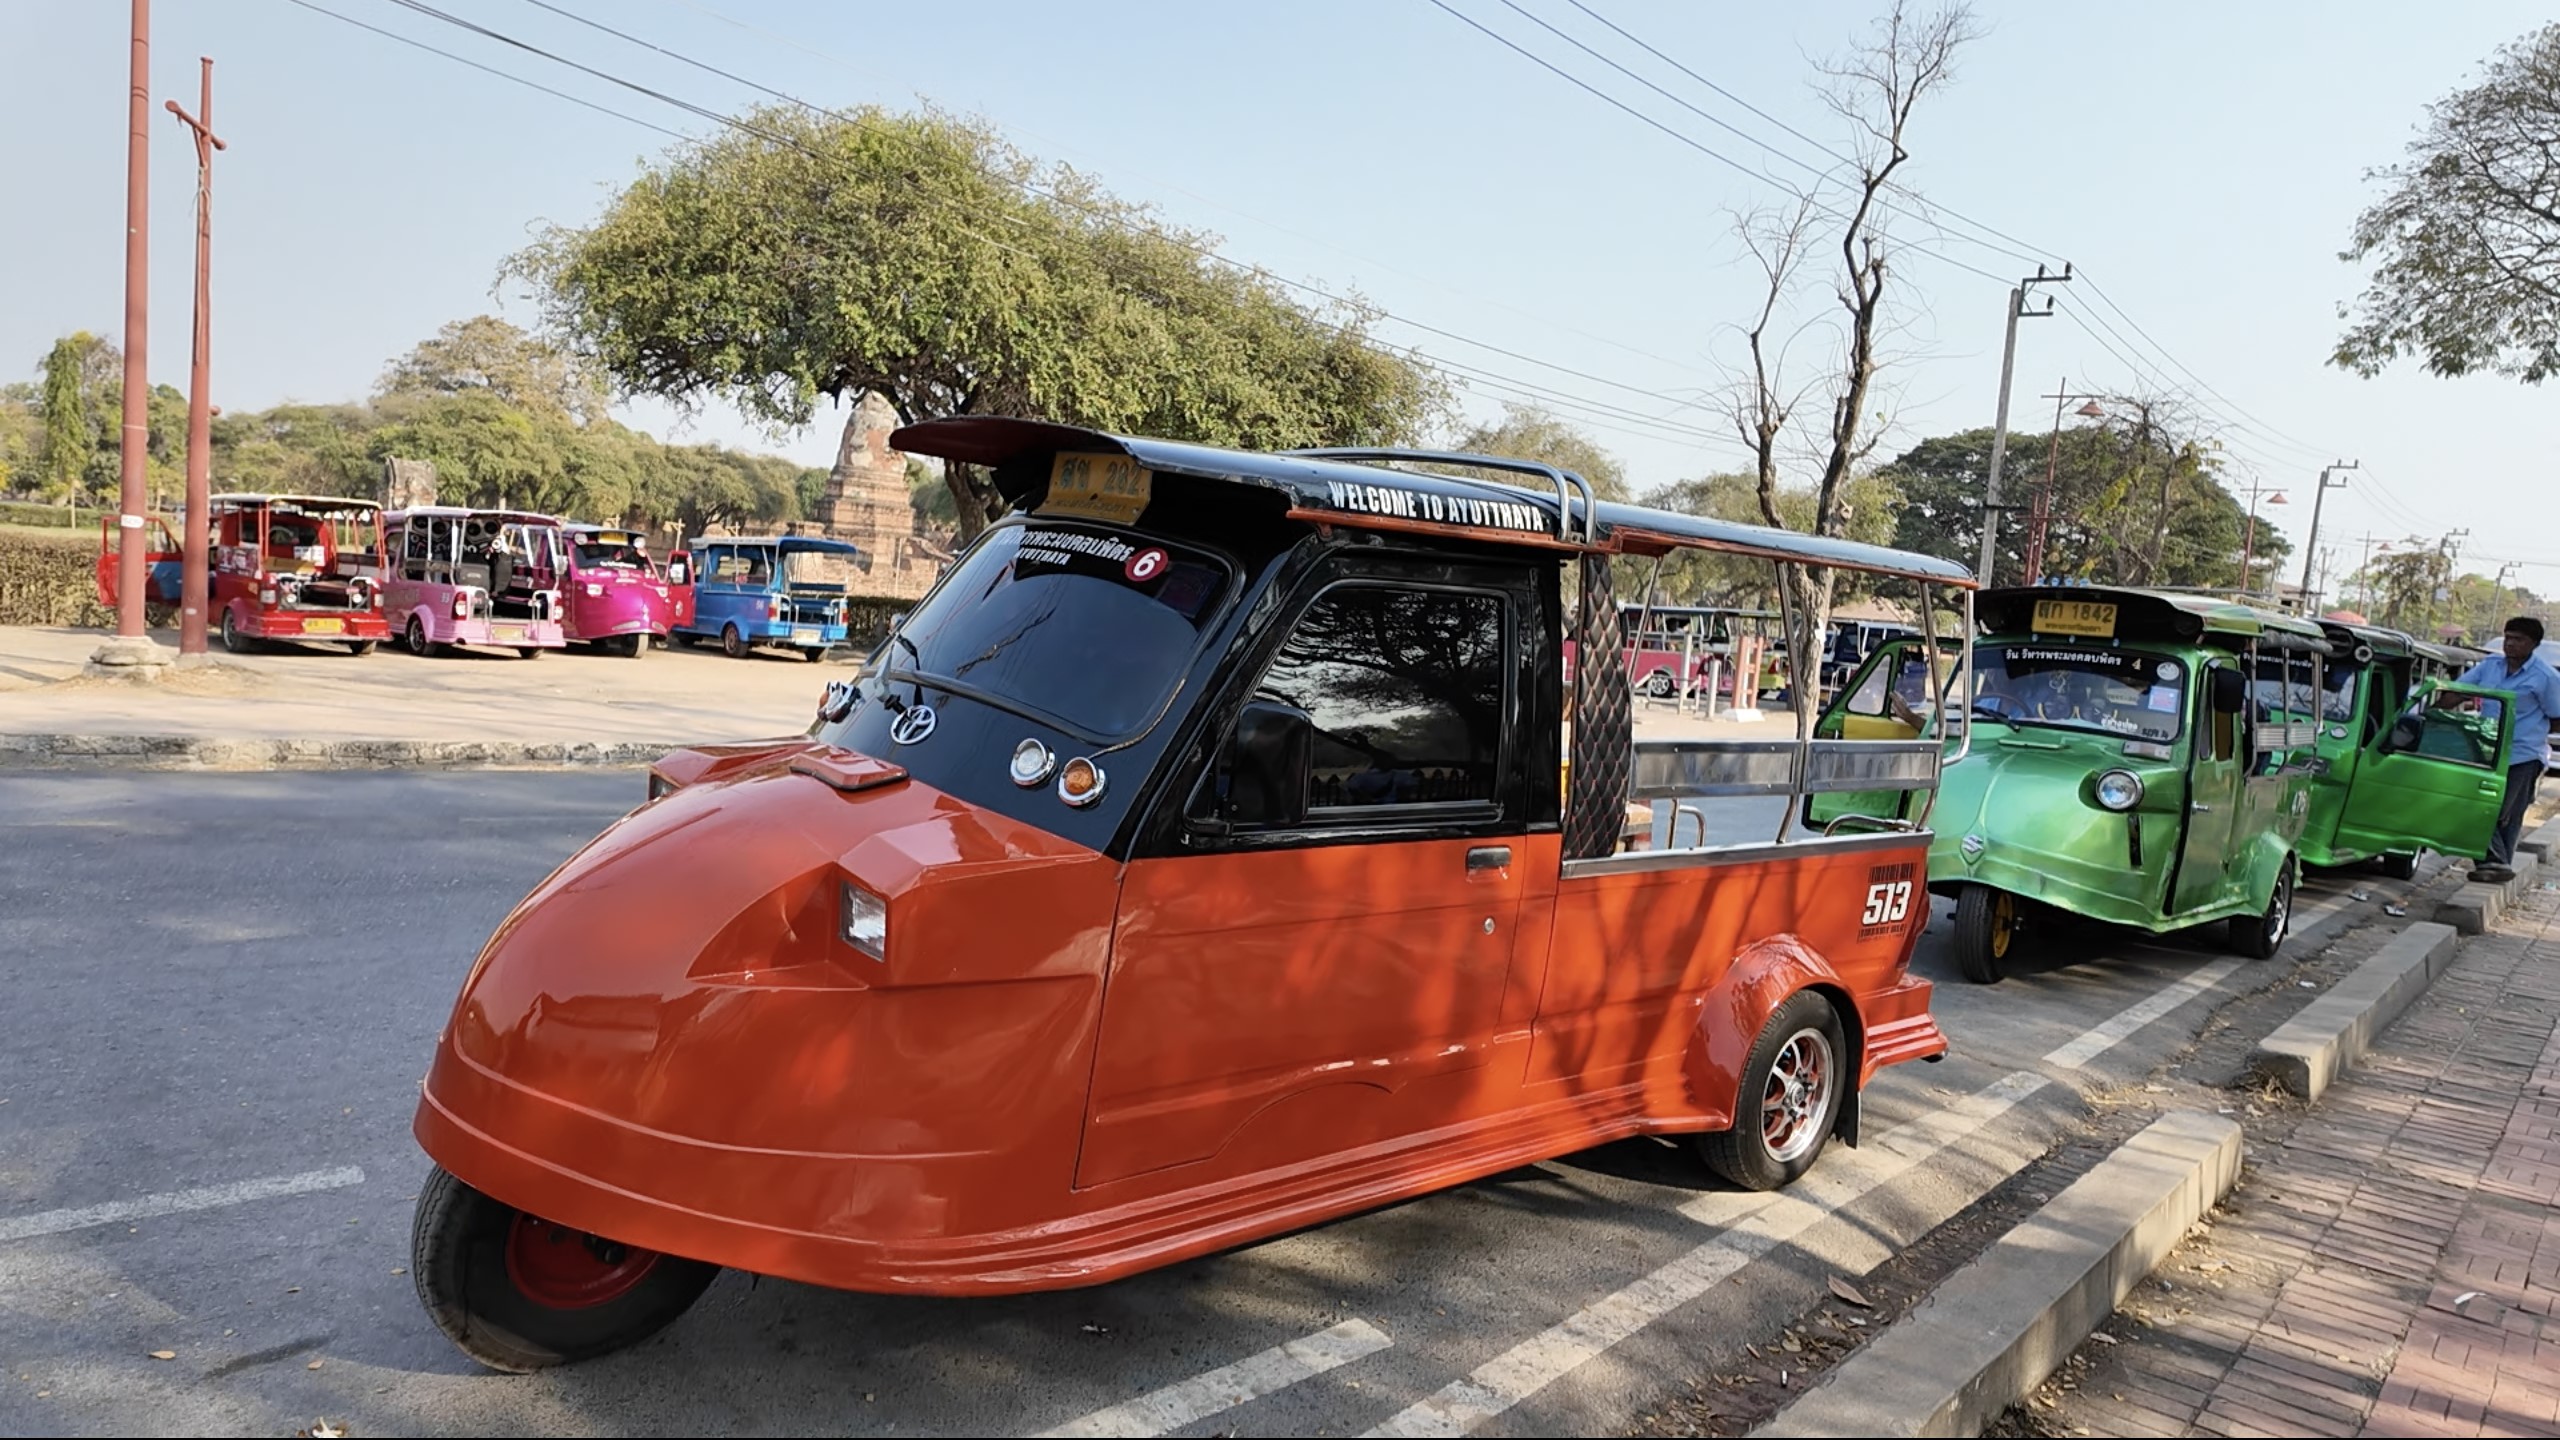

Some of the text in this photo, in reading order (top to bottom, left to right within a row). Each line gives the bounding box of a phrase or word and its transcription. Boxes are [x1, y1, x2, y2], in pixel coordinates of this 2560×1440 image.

[1327, 481, 1544, 531] WELCOME TO AYUTTHAYA
[1132, 551, 1161, 577] 6
[2071, 603, 2114, 624] 1842
[2131, 657, 2142, 671] 4
[1862, 880, 1913, 925] 513
